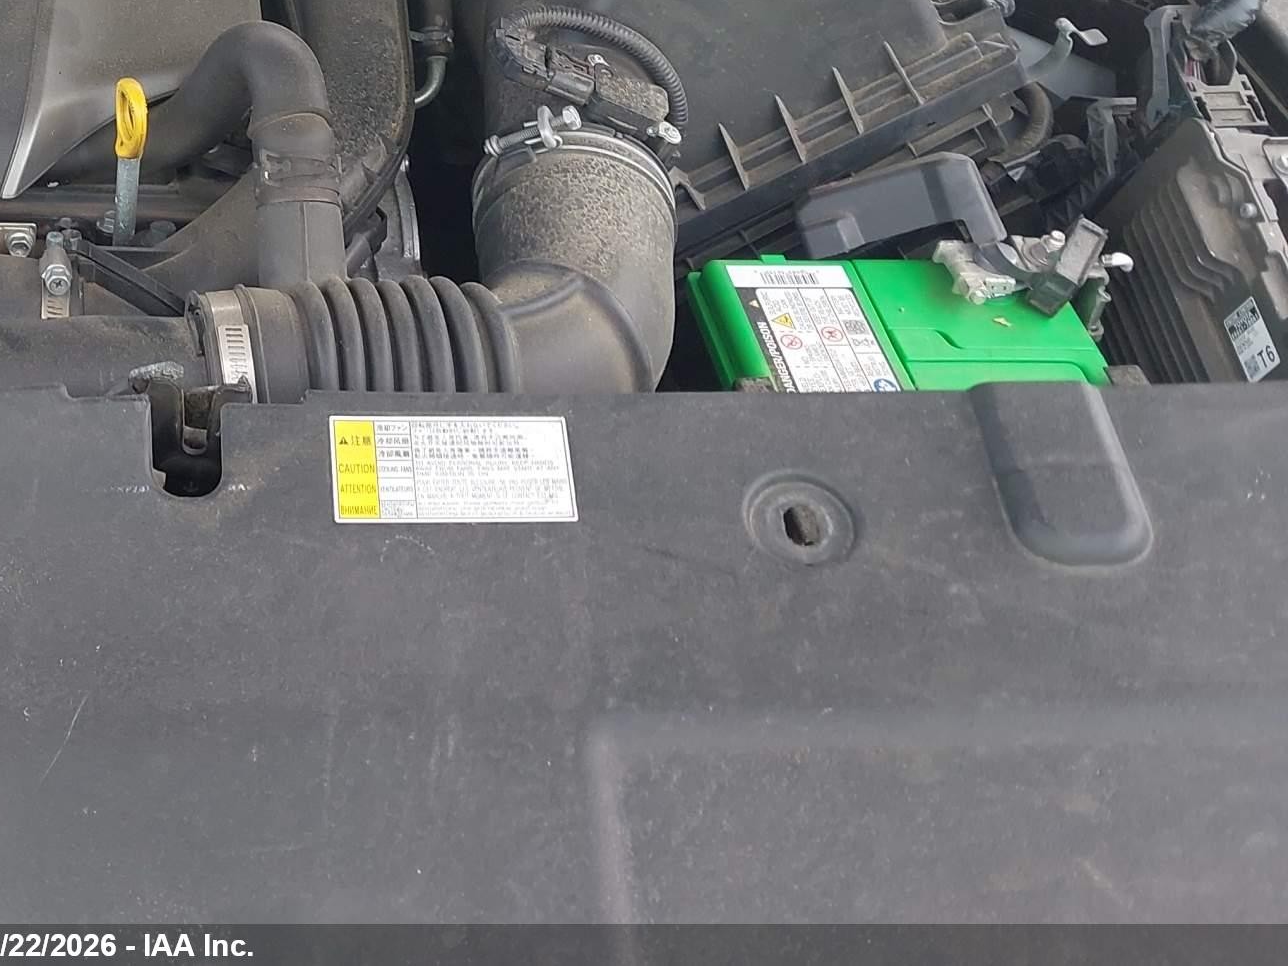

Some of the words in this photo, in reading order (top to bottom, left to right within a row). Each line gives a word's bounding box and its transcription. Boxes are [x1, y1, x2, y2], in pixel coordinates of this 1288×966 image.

[338, 463, 375, 474] CAUTION
[340, 483, 377, 494] ATTENTION
[340, 505, 378, 516] ВНИМАНИЕ
